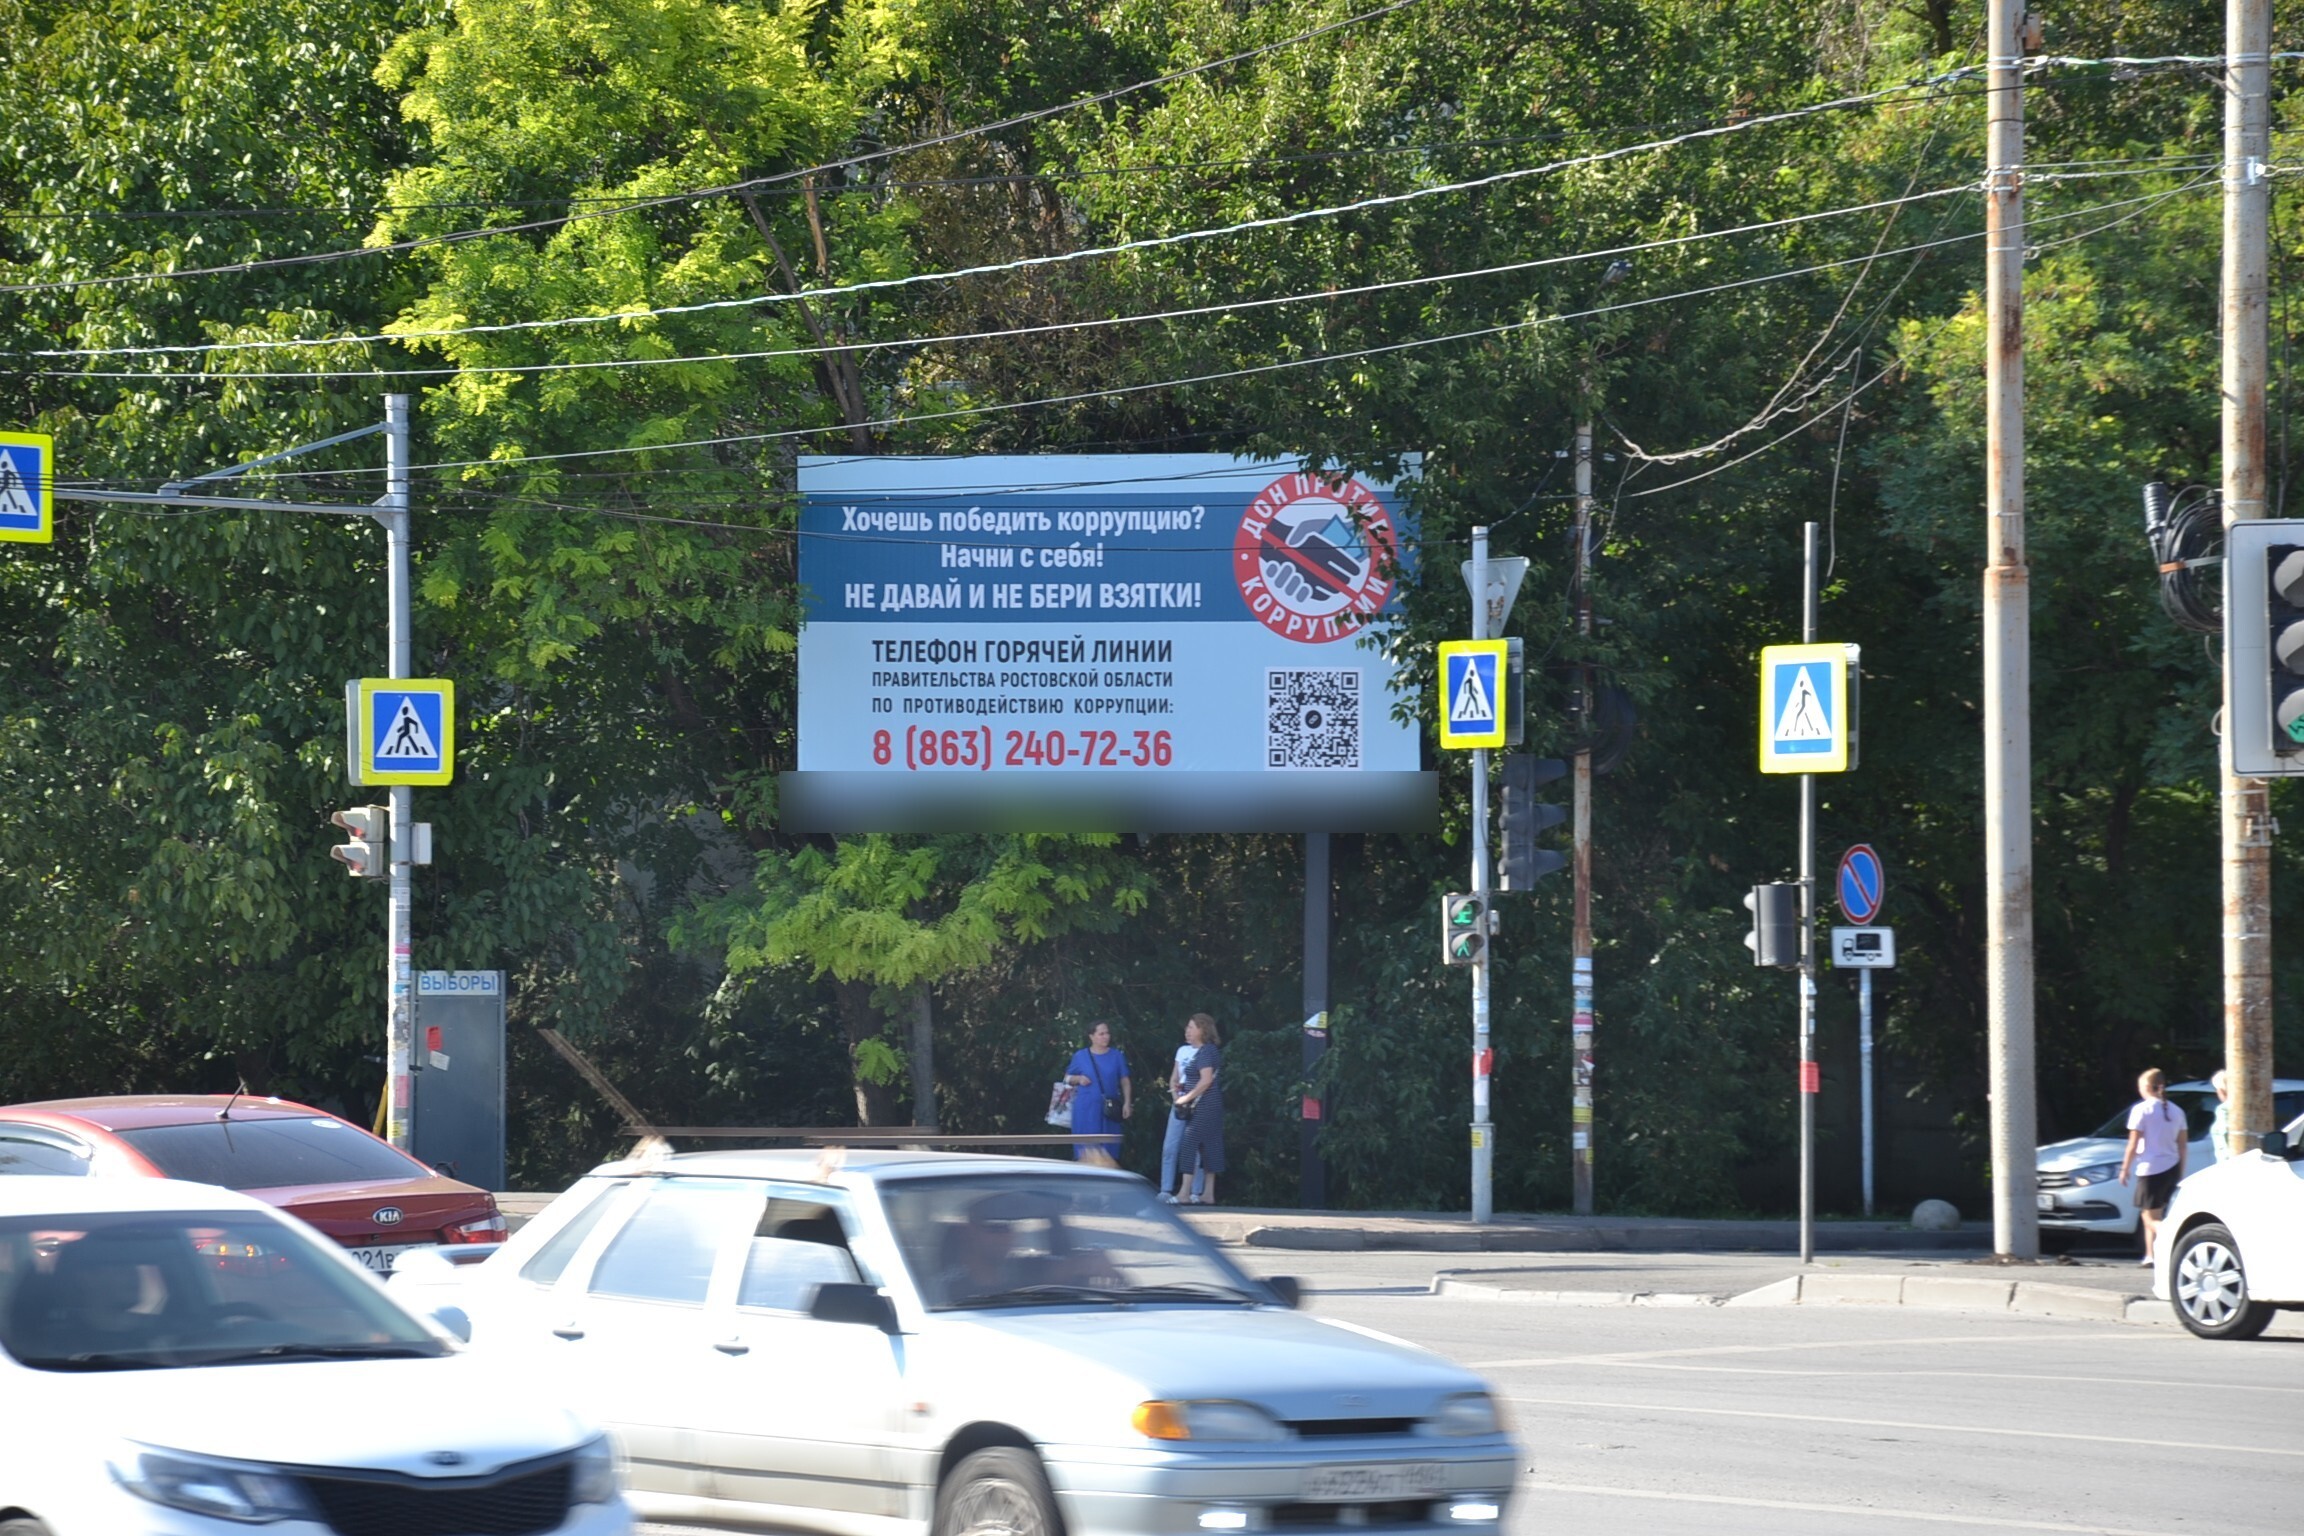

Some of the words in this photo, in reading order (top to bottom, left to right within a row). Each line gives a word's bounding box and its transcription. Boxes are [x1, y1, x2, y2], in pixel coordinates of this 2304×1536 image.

[842, 506, 933, 531] Хочешь
[939, 507, 1052, 535] победить
[1058, 506, 1206, 537] коррупцию?
[1241, 484, 1288, 540] ДОН
[941, 543, 1013, 568] Начни
[1020, 548, 1034, 568] с
[1040, 541, 1103, 568] себя!
[846, 583, 875, 608] НЕ
[881, 579, 961, 612] ДАВАЙ
[969, 584, 985, 609] И
[993, 583, 1023, 608] НЕ
[1030, 583, 1092, 608] БЕРИ
[1100, 582, 1202, 608] ВЗЯТКИ!
[1241, 575, 1388, 640] КОРРУПЦИИ
[872, 638, 977, 665] ТЕЛЕФОН
[985, 634, 1085, 664] ГОРЯЧЕЙ
[1091, 639, 1173, 663] ЛИНИИ
[872, 672, 996, 688] ПРАВИТЕЛЬСТВА
[1001, 669, 1099, 688] РОСТОВСКОЙ
[1103, 672, 1173, 688] ОБЛАСТИ
[872, 698, 893, 713] ПО
[903, 695, 1064, 714] ПРОТИВОДЕЙСТВИЮ
[1074, 697, 1174, 716] КОРРУПЦИИ:
[873, 730, 892, 765] 8
[907, 725, 992, 771] (863)
[1006, 730, 1172, 766] 240-72-36
[420, 975, 497, 991] ВЫБОРЫ
[379, 1211, 400, 1222] KIA
